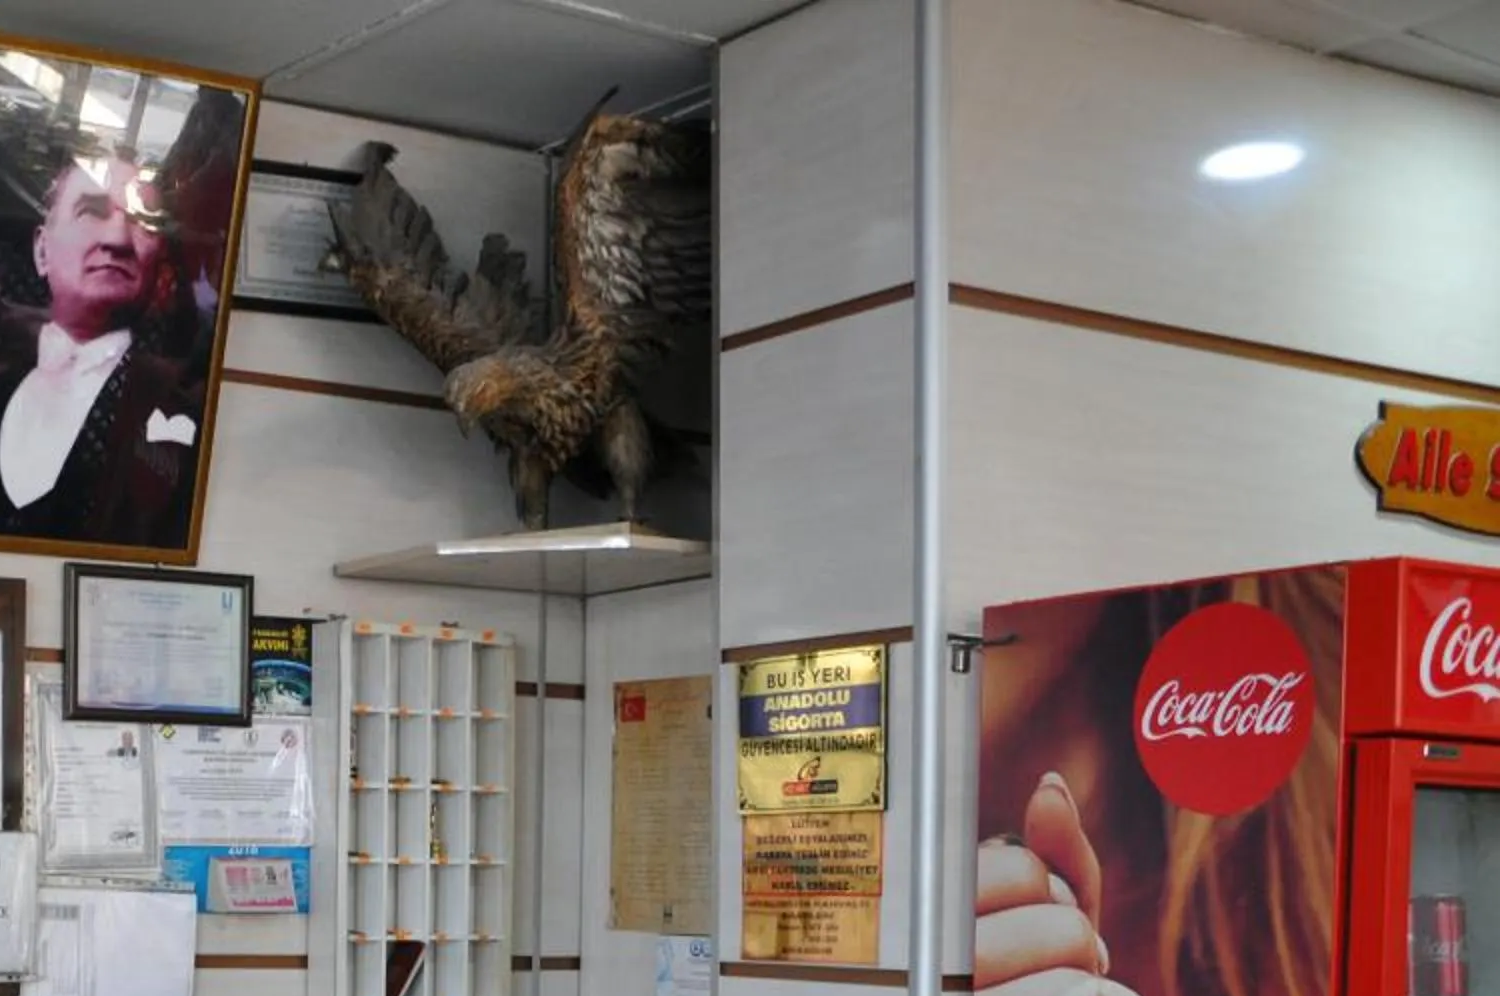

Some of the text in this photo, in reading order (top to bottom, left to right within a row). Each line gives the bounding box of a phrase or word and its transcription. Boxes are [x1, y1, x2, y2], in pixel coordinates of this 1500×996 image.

[767, 673, 787, 689] BU
[763, 688, 850, 713] ANADOLU
[1141, 672, 1306, 741] Coca-Cola
[768, 711, 846, 732] SİGORTA
